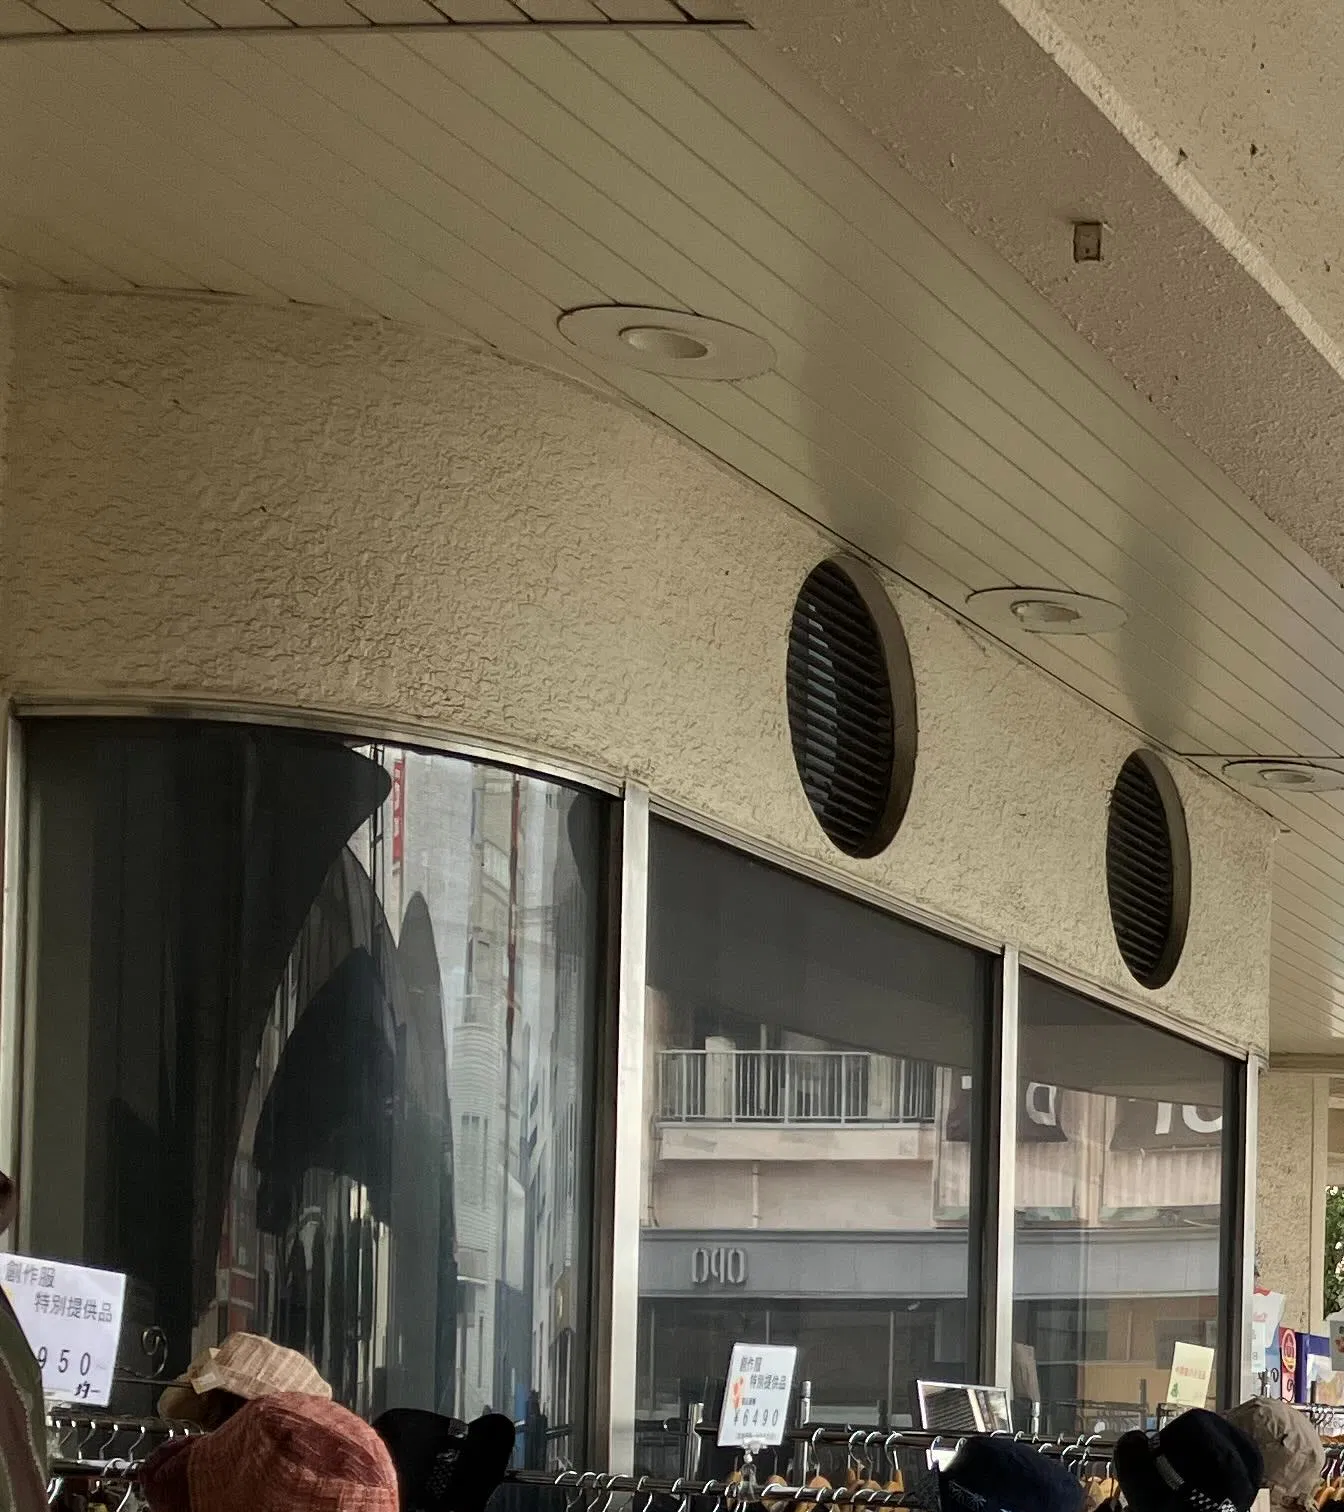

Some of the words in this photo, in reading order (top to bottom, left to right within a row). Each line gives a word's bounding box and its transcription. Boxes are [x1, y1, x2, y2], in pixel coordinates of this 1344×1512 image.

[5, 1260, 56, 1288] 創作服
[34, 1291, 113, 1322] 特別提供品
